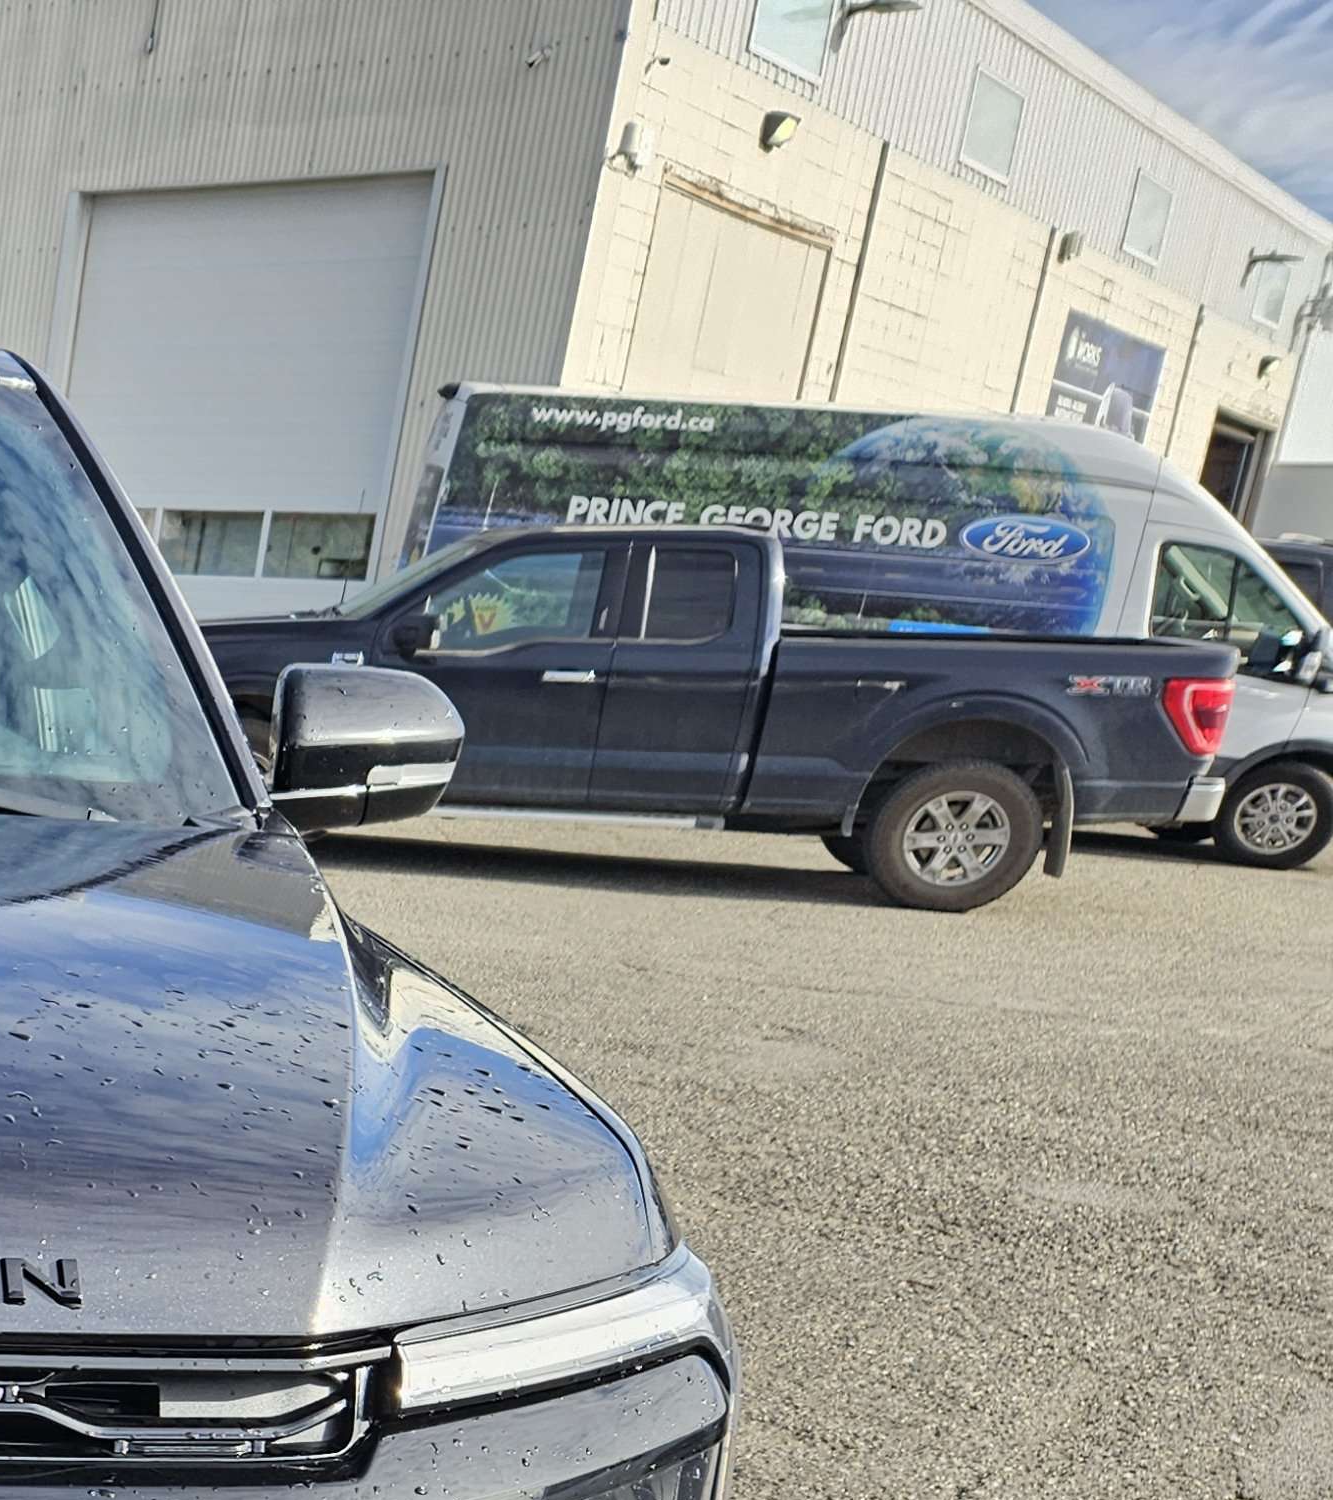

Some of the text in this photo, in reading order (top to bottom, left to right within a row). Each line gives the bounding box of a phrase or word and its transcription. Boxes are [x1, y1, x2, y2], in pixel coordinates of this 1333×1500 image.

[532, 406, 715, 433] www.pgford.ca
[565, 495, 947, 549] PRINCE GEORGE FORD
[982, 519, 1070, 559] Ford
